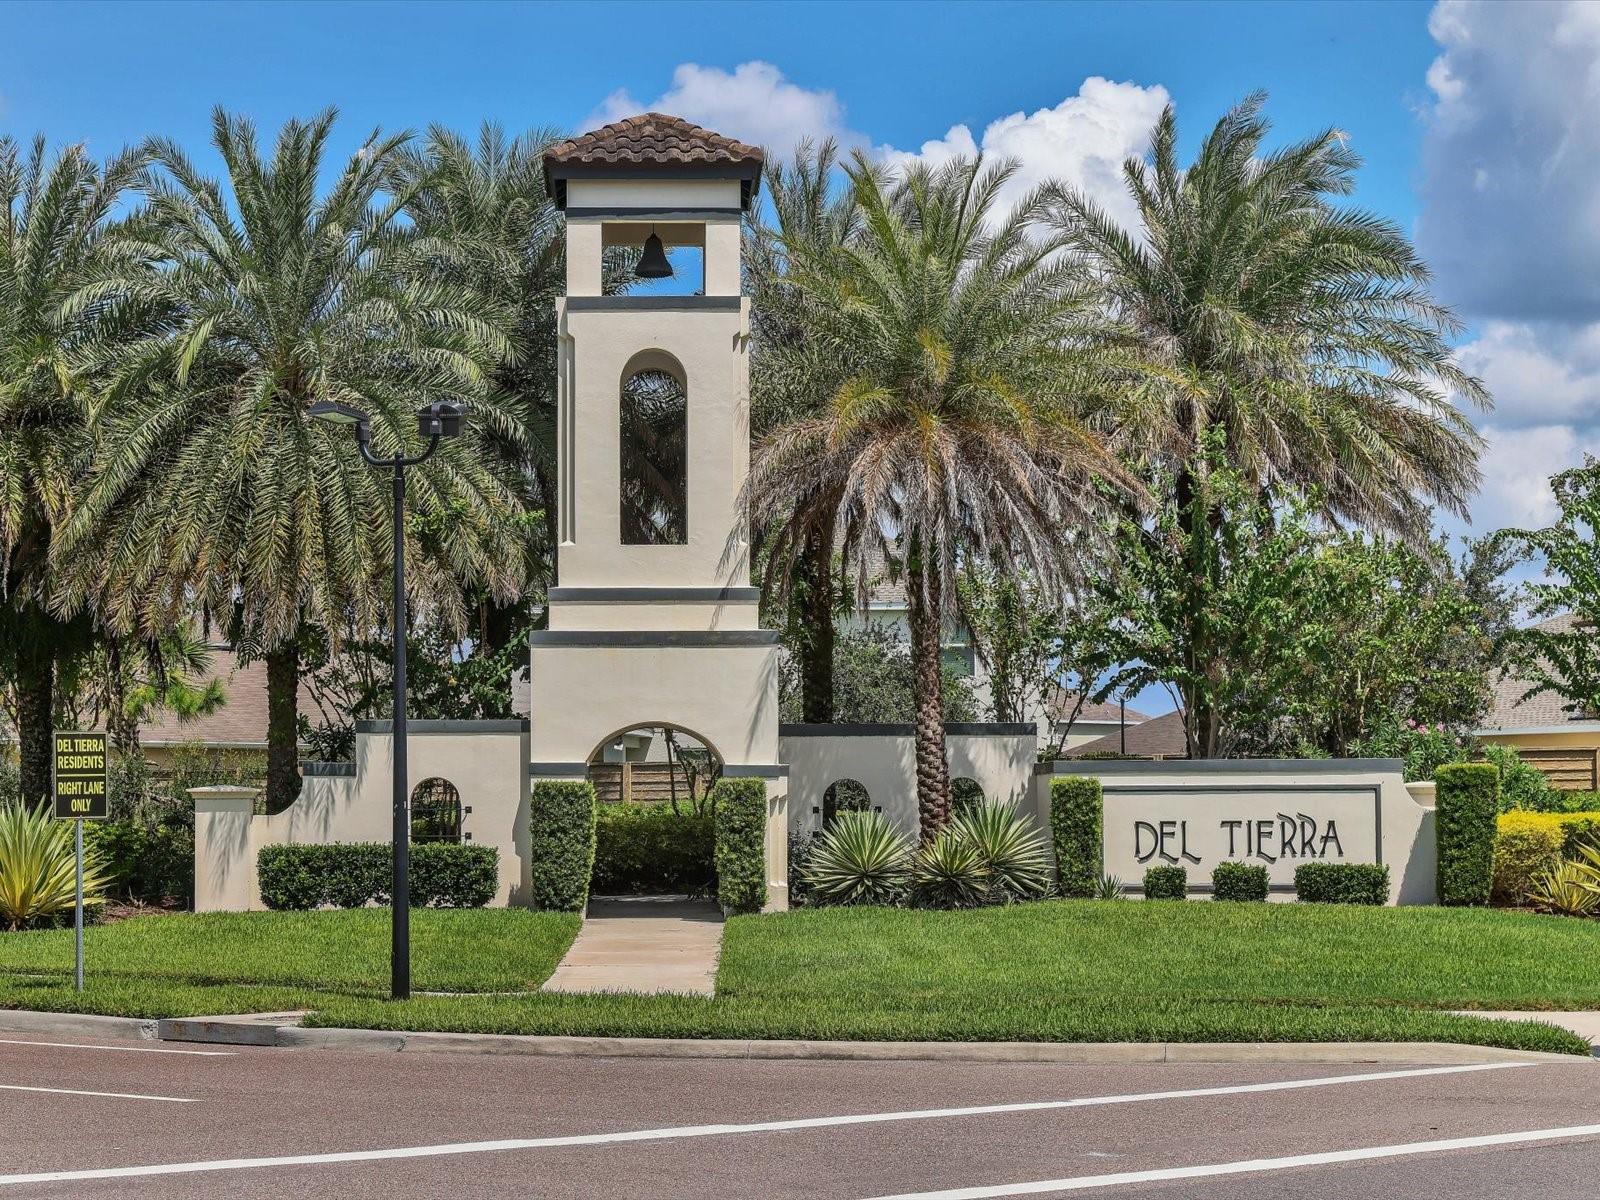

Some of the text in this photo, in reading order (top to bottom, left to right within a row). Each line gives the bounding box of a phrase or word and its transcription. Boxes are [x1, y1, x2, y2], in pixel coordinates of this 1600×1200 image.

[56, 739, 104, 752] DEL TIERRA
[57, 755, 104, 769] RESIDENTS
[58, 781, 104, 795] RIGHT LANE
[71, 798, 91, 812] ONLY
[1134, 812, 1343, 865] DEL TIERRA
